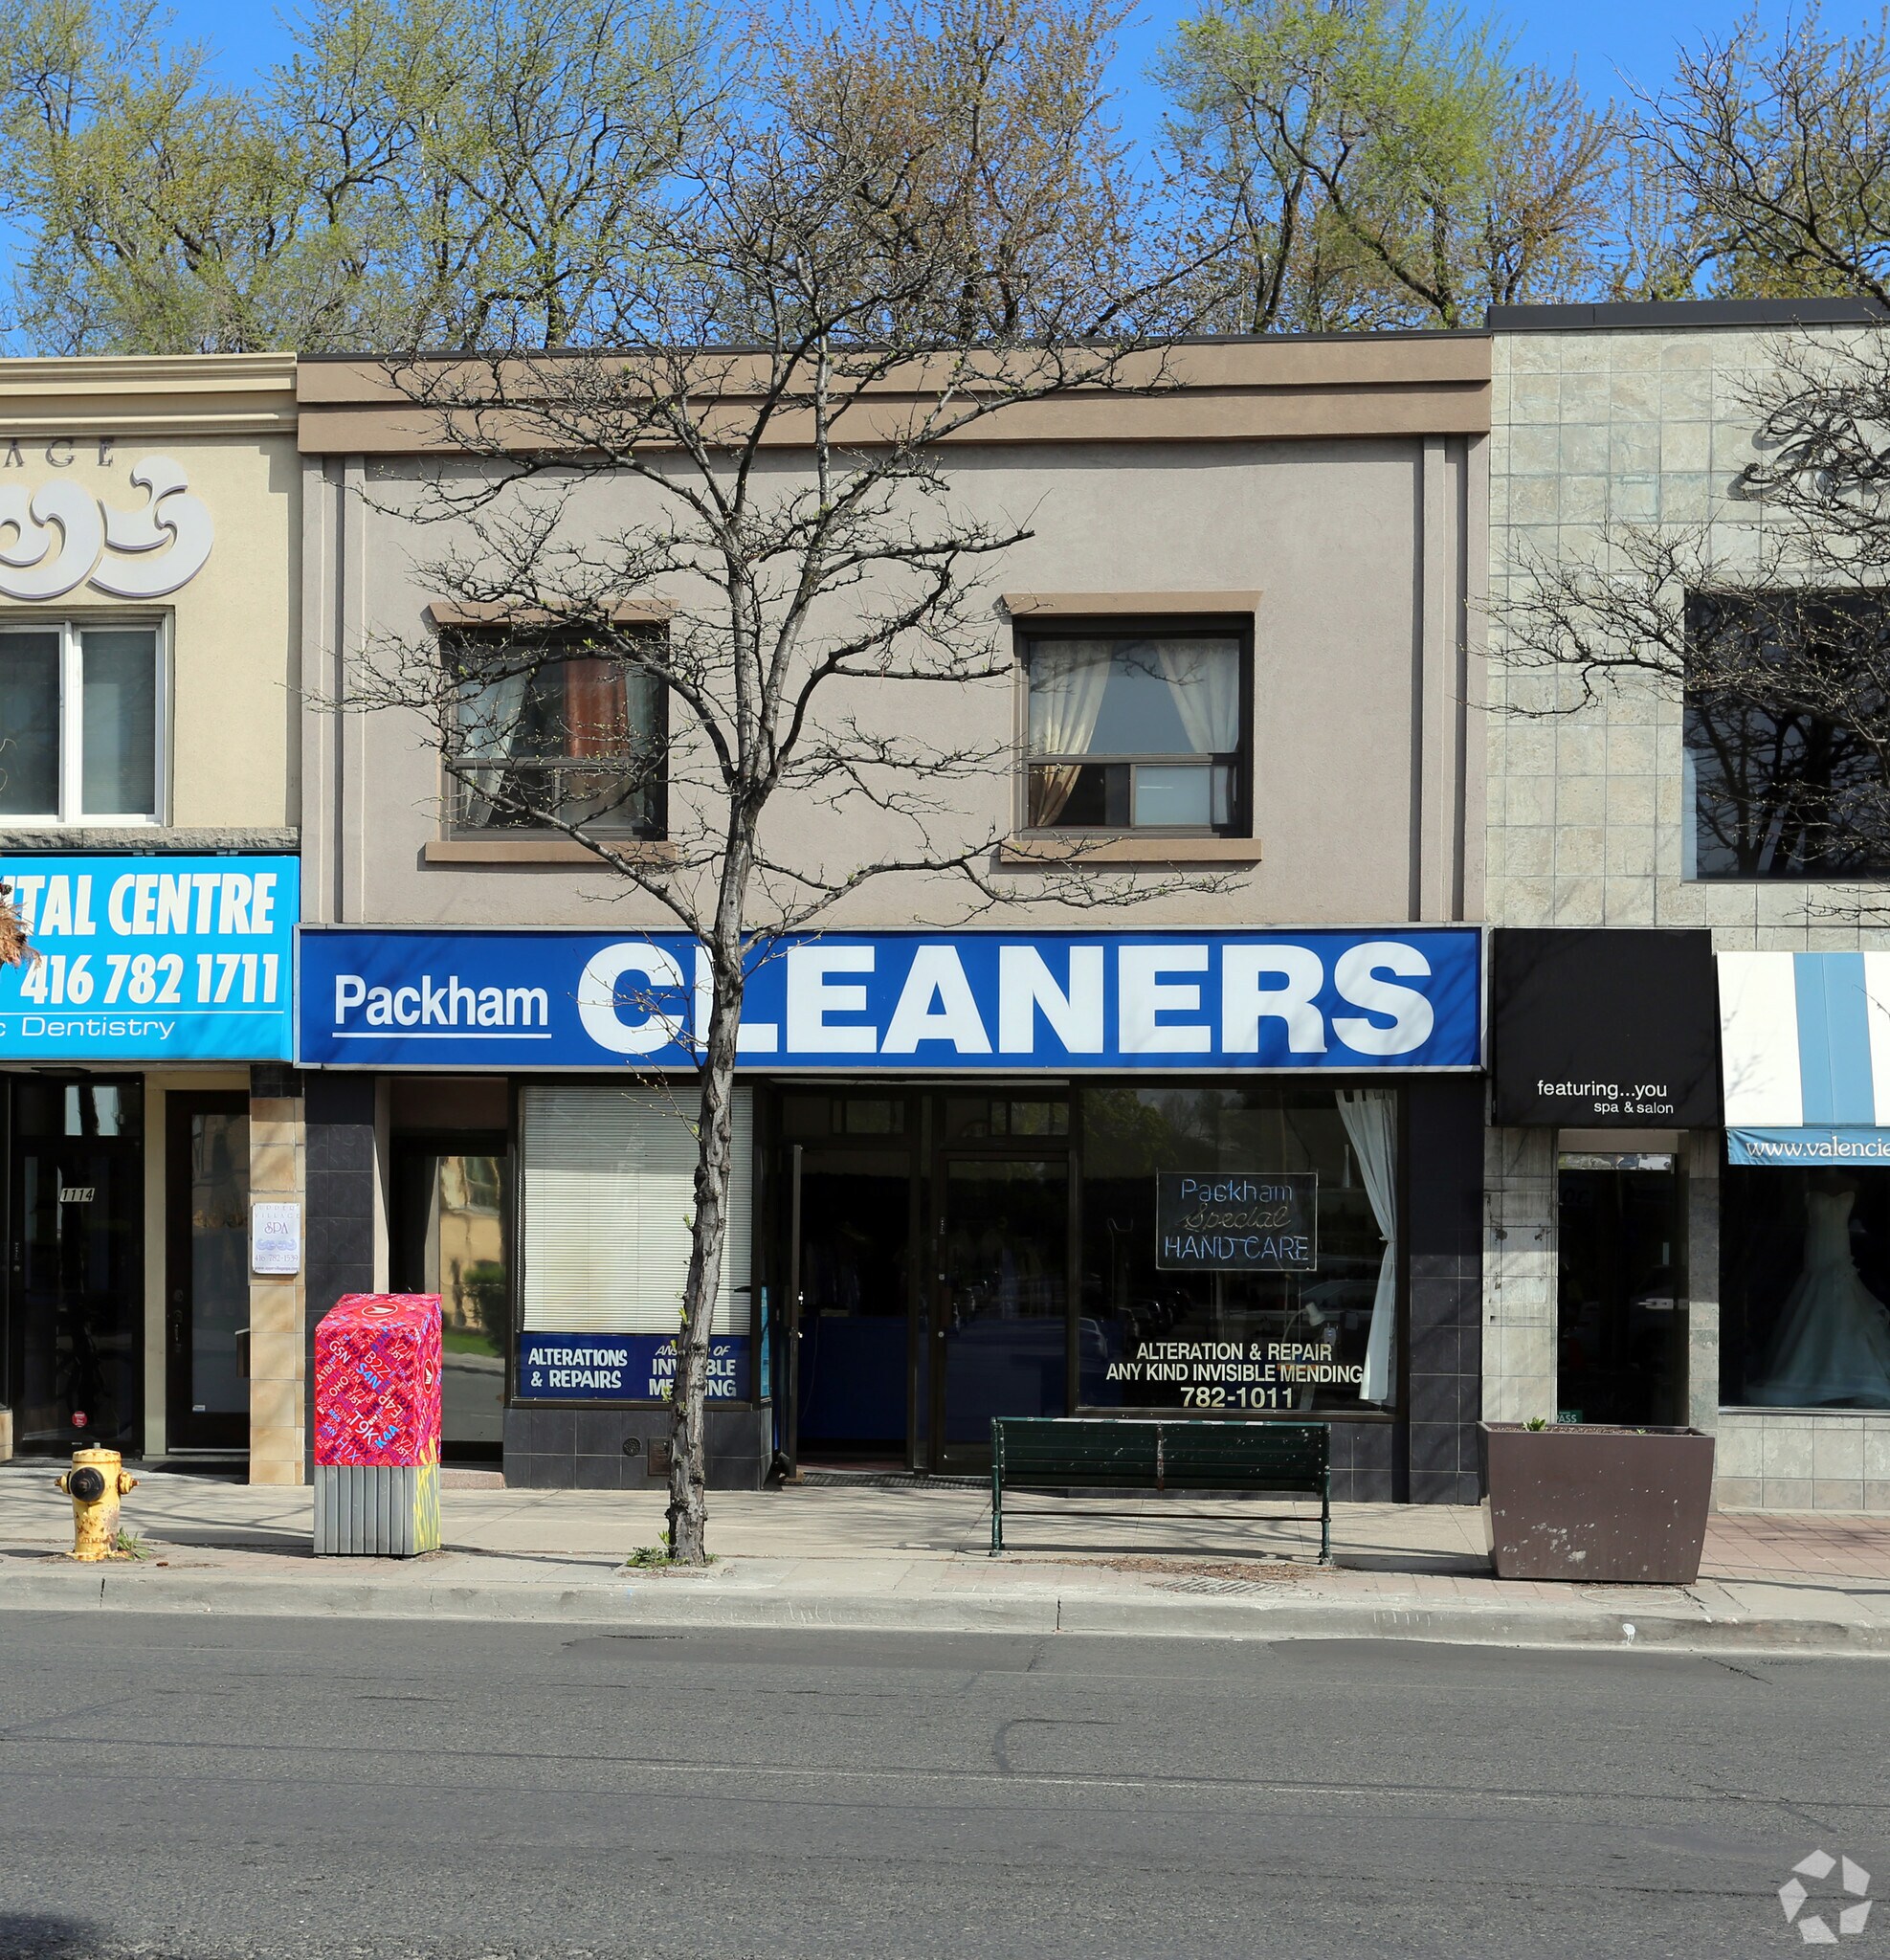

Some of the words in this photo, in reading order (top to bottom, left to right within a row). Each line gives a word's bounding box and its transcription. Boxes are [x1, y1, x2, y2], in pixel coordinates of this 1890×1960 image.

[0, 873, 96, 936] TAL
[108, 873, 278, 937] CENTRE
[20, 954, 95, 1005] 416
[102, 953, 185, 1005] 782
[197, 953, 279, 1004] 1711
[335, 974, 549, 1027] Packham
[577, 941, 1434, 1056] CLEANERS
[22, 1016, 176, 1040] Dentistry
[1593, 1102, 1619, 1115] spa
[1624, 1102, 1634, 1113] &
[1636, 1102, 1675, 1114] salon
[62, 1189, 94, 1201] 1114
[1181, 1178, 1293, 1203] Packham
[1176, 1201, 1292, 1233] Special
[264, 1221, 289, 1235] SPA
[255, 1254, 266, 1262] 416
[1165, 1236, 1235, 1260] HAND
[1244, 1236, 1309, 1261] CARE
[527, 1348, 628, 1367] ALTERATIONS
[713, 1345, 730, 1356] OF
[1136, 1342, 1244, 1361] ALTERATION
[1249, 1343, 1261, 1361] &
[1267, 1343, 1333, 1361] REPAIR
[530, 1370, 543, 1388] &
[548, 1370, 622, 1389] REPAIRS
[1105, 1363, 1142, 1381] ANY
[1146, 1364, 1189, 1381] KIND
[1193, 1364, 1276, 1382] INVISIBLE
[1280, 1365, 1364, 1383] MENDING
[1180, 1387, 1293, 1409] 782-1011
